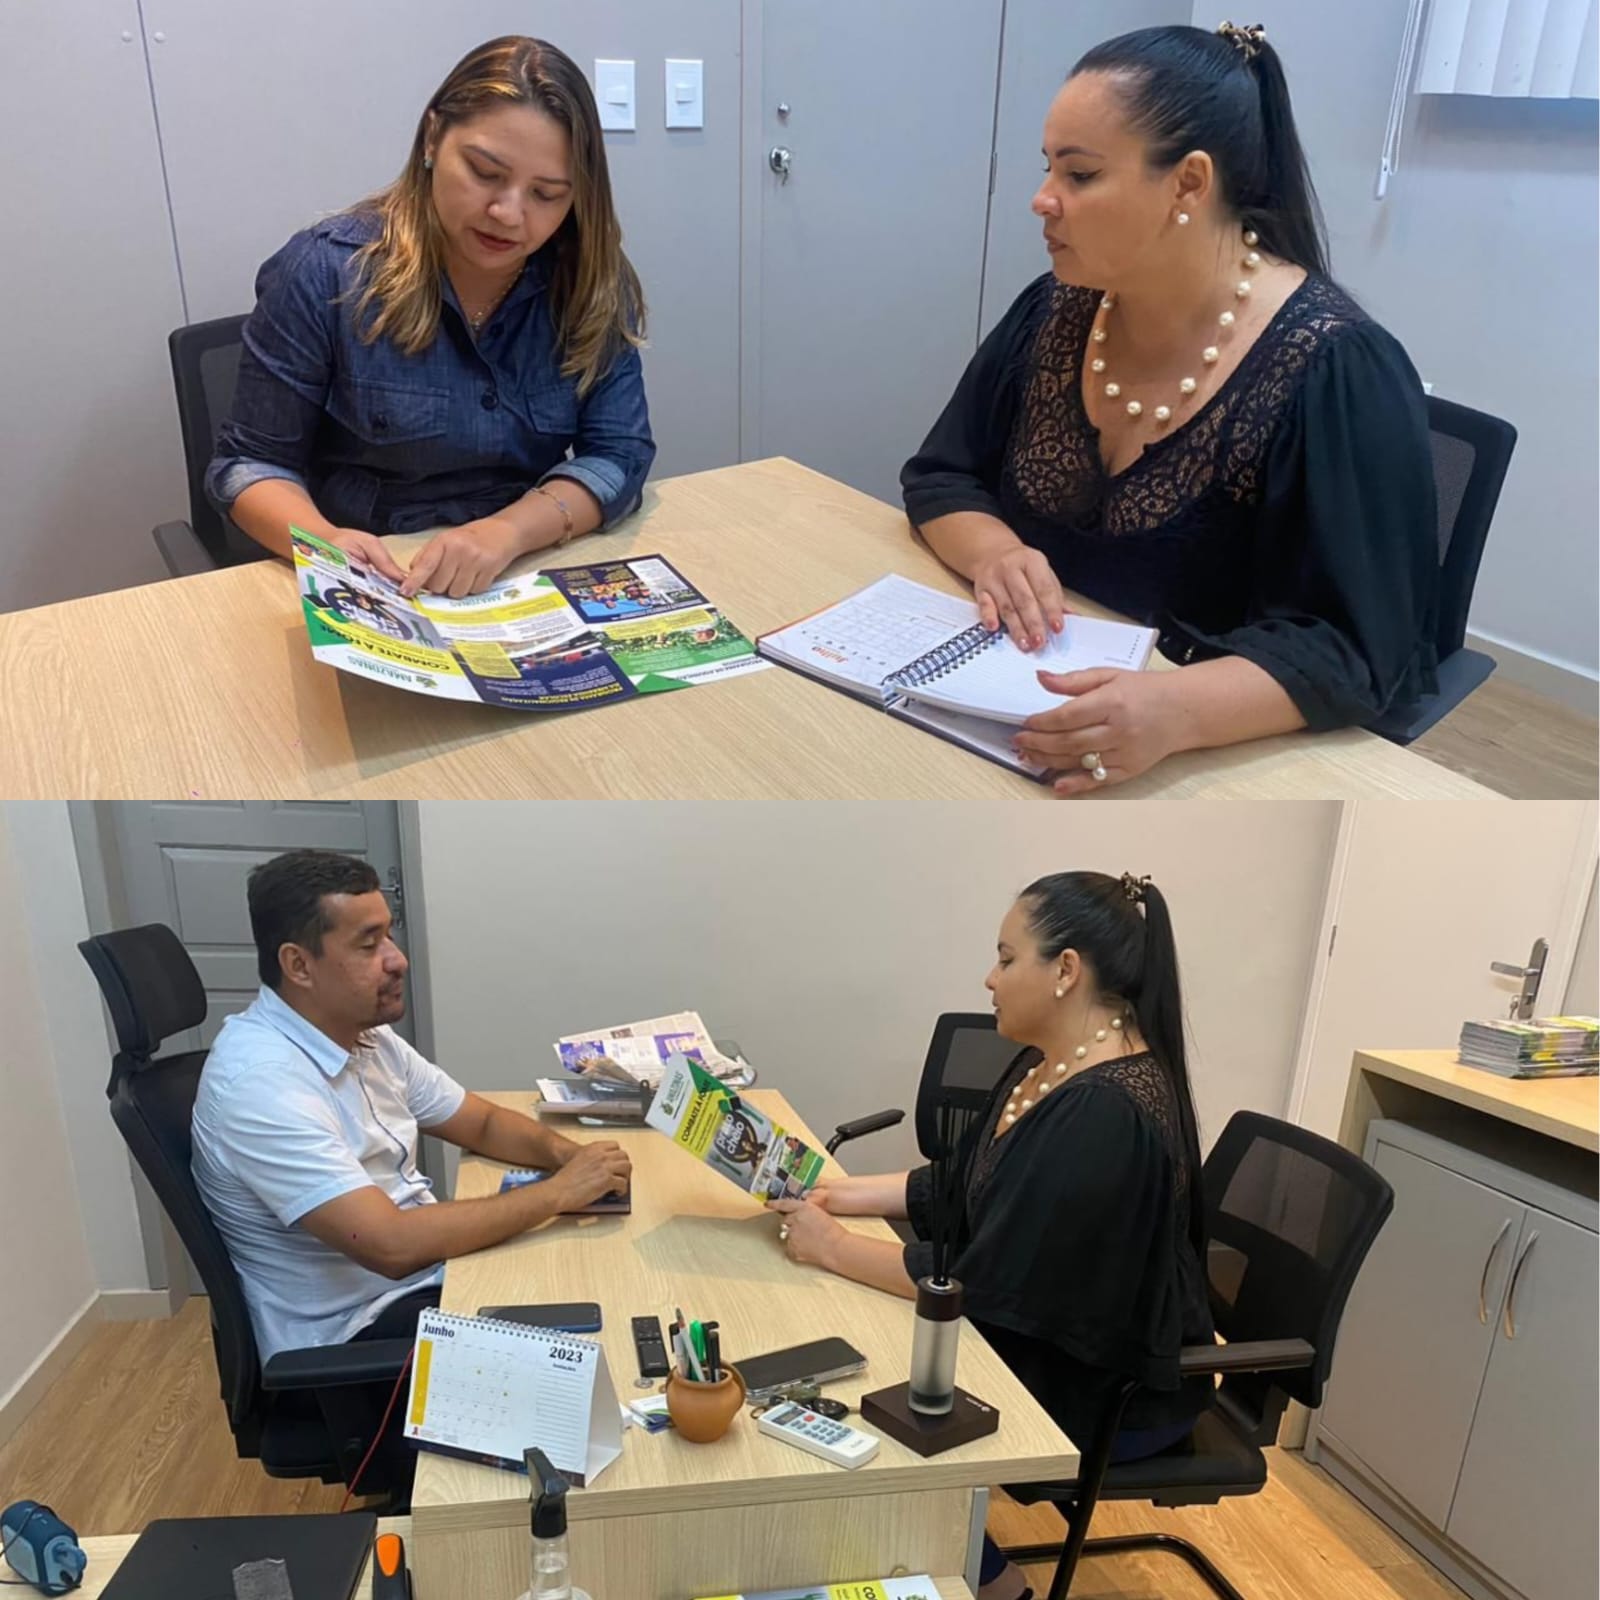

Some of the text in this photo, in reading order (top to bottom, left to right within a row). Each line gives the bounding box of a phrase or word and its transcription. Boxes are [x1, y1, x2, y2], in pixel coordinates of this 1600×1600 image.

[379, 647, 451, 672] COMBATE
[810, 645, 849, 664] Julho
[346, 655, 412, 683] AMAZONAS
[666, 1071, 685, 1102] AMAZONAS
[680, 1105, 702, 1142] COMBATE
[726, 1120, 746, 1154] cheio
[421, 1322, 456, 1338] Junho
[549, 1346, 583, 1364] 2023
